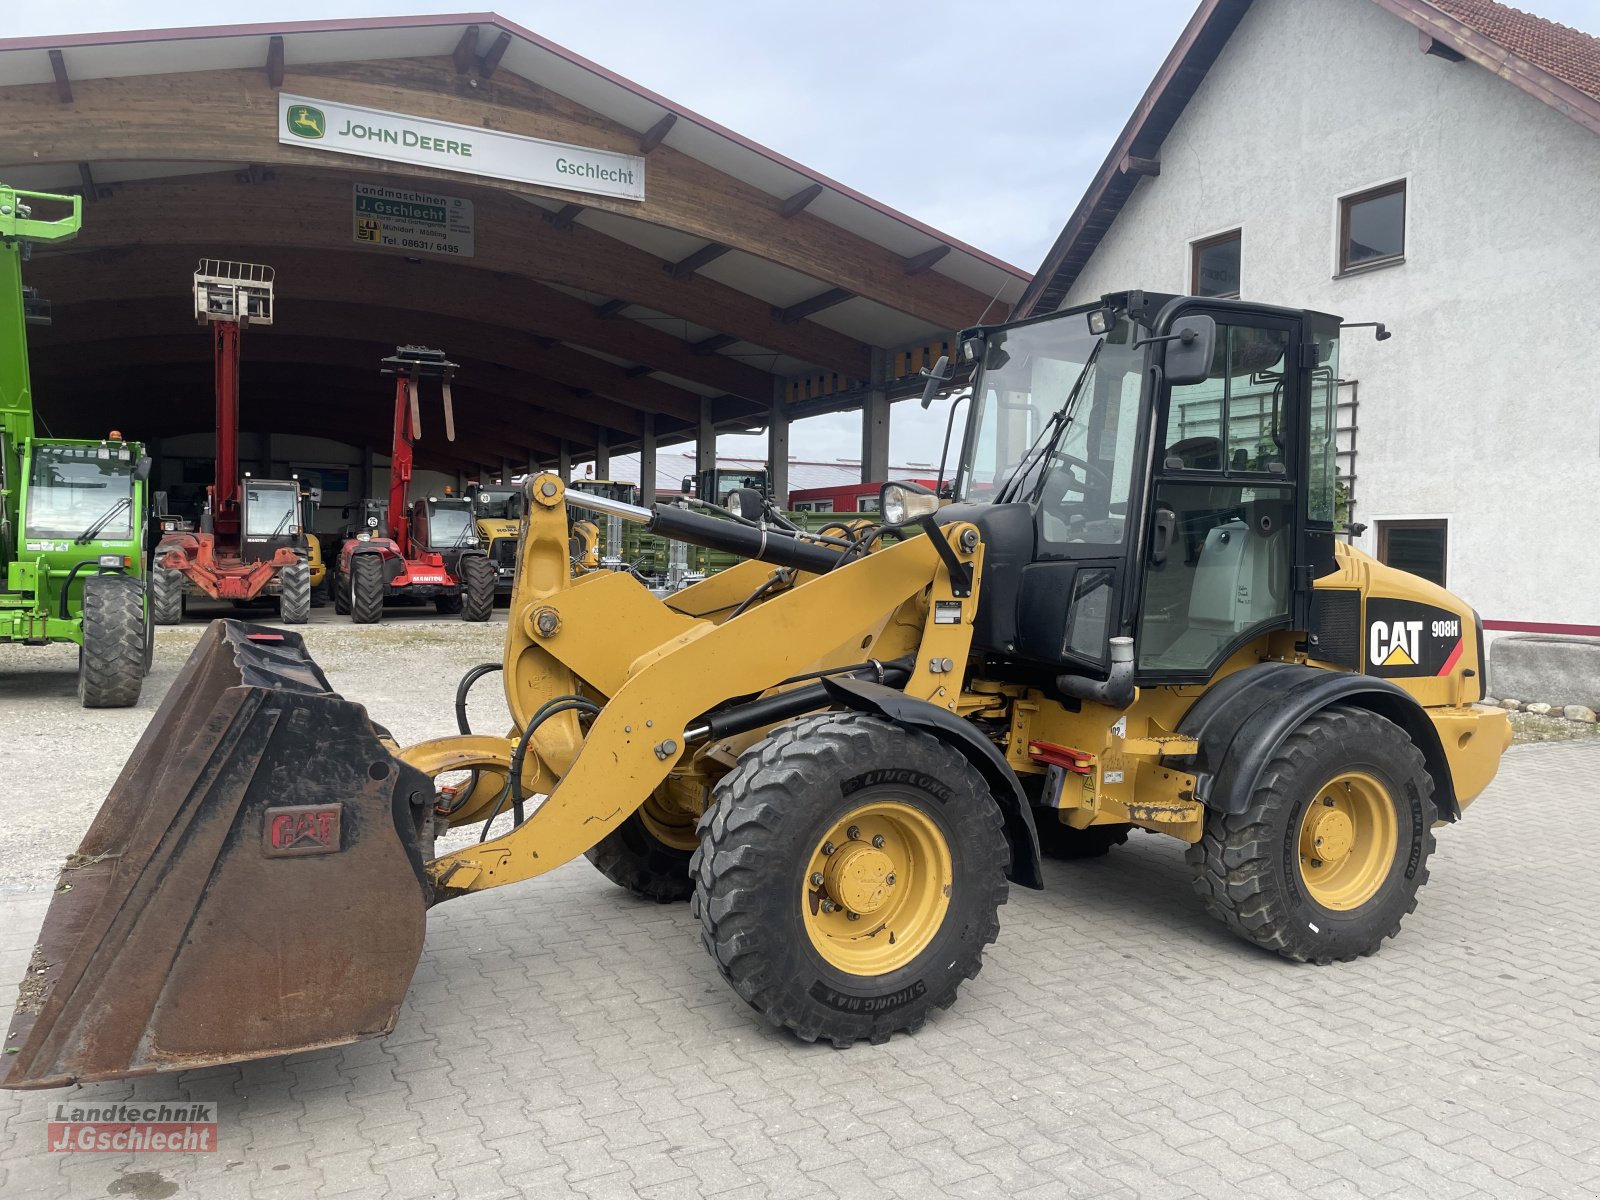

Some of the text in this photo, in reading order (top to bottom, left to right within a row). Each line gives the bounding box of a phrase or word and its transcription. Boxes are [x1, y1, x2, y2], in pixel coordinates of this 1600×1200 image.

[339, 120, 472, 157] JOHN DEERE
[555, 158, 634, 185] Gschlecht
[355, 184, 447, 206] Landmaschinen
[359, 199, 444, 221] J. Gschlecht
[382, 236, 399, 246] Tel.
[402, 239, 428, 250] 08631
[436, 244, 459, 254] 6495
[1370, 620, 1458, 666] CAT 908H
[865, 770, 950, 801] LINGLONG
[271, 812, 336, 850] CAT
